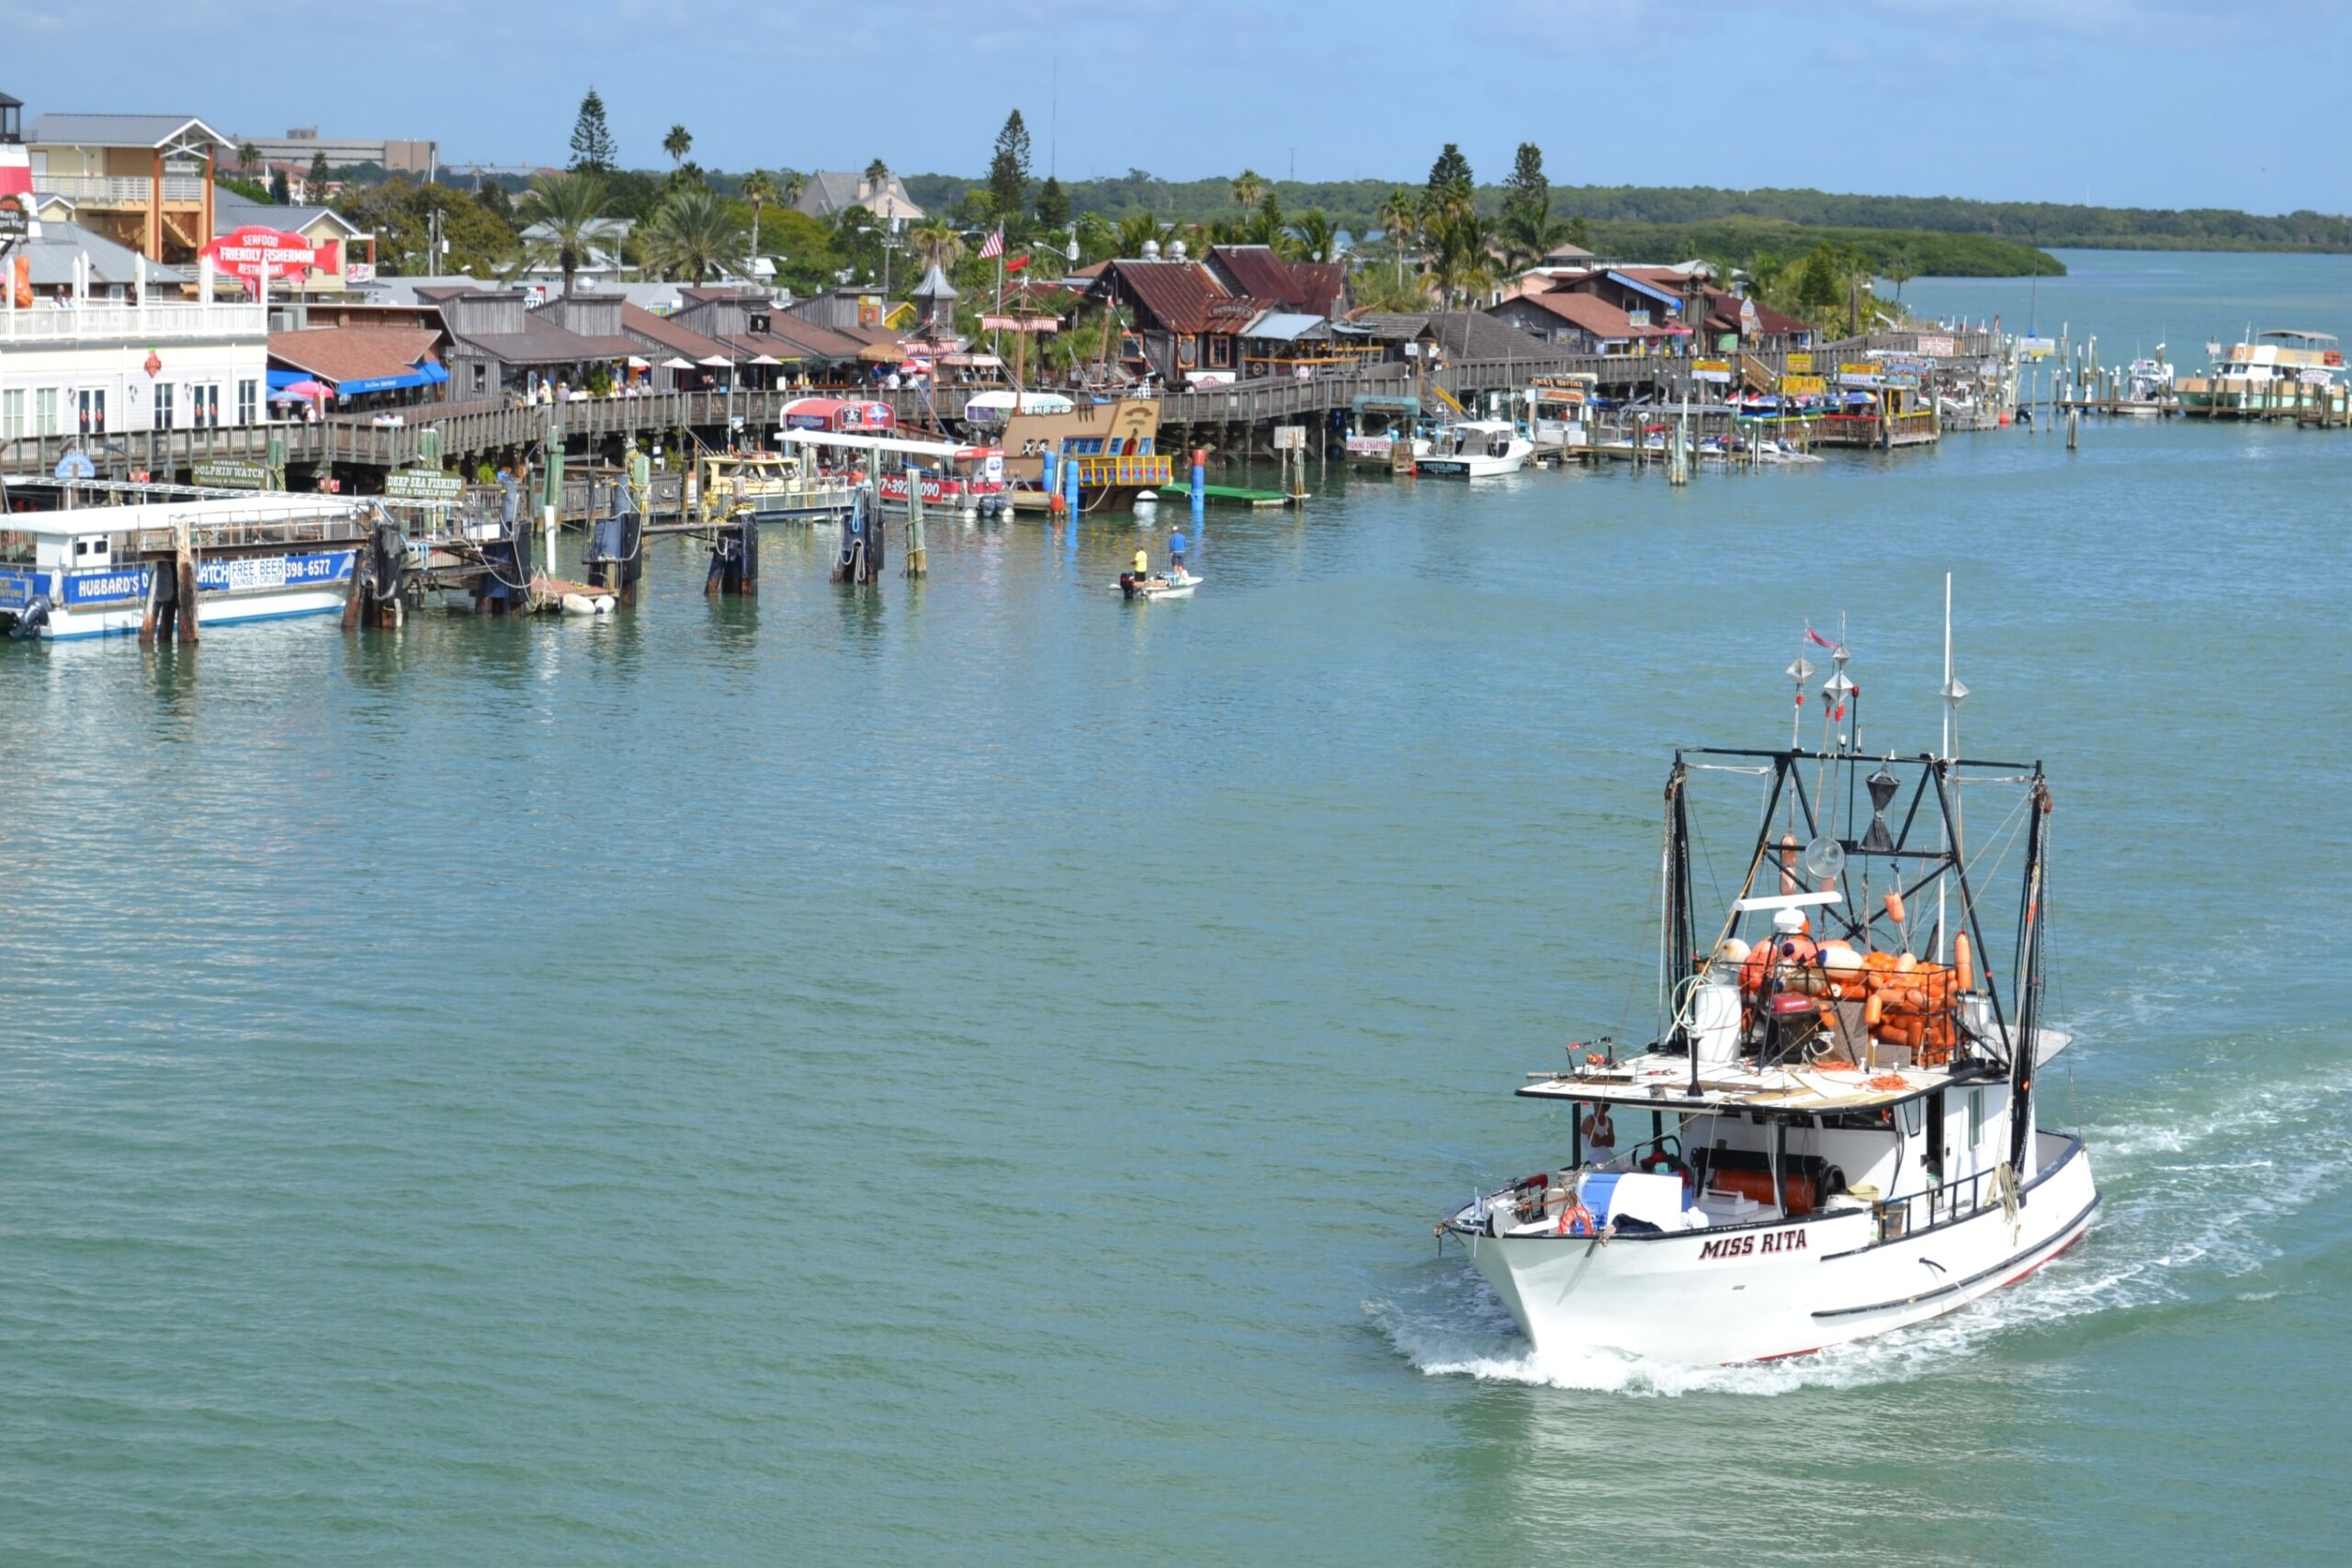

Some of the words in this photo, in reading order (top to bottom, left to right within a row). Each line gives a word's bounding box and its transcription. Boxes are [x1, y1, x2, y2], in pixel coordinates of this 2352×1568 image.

[242, 235, 278, 247] SEAFOOD
[220, 246, 262, 261] FRIENDLY
[263, 248, 315, 263] FISHERMAN
[237, 263, 284, 275] RESTAANT
[1346, 440, 1364, 450] FISHING
[1365, 439, 1392, 450] CHARTERS
[194, 465, 233, 476] DOLPHIN
[233, 468, 265, 478] WATCH
[408, 469, 441, 478] HUBBARD'S
[387, 476, 410, 487] DEEP
[410, 477, 425, 488] SEA
[427, 478, 462, 490] FISHING
[413, 488, 438, 496] TACKLE
[232, 561, 254, 577] FREE
[259, 559, 284, 575] BEER
[78, 575, 139, 597] HUBBARD'S
[197, 564, 229, 583] ATCH
[286, 558, 331, 578] 398-6577
[232, 577, 258, 586] SUNSET
[259, 575, 284, 584] CRUISE
[1698, 1235, 1756, 1260] MISS
[1760, 1228, 1807, 1254] RITA
